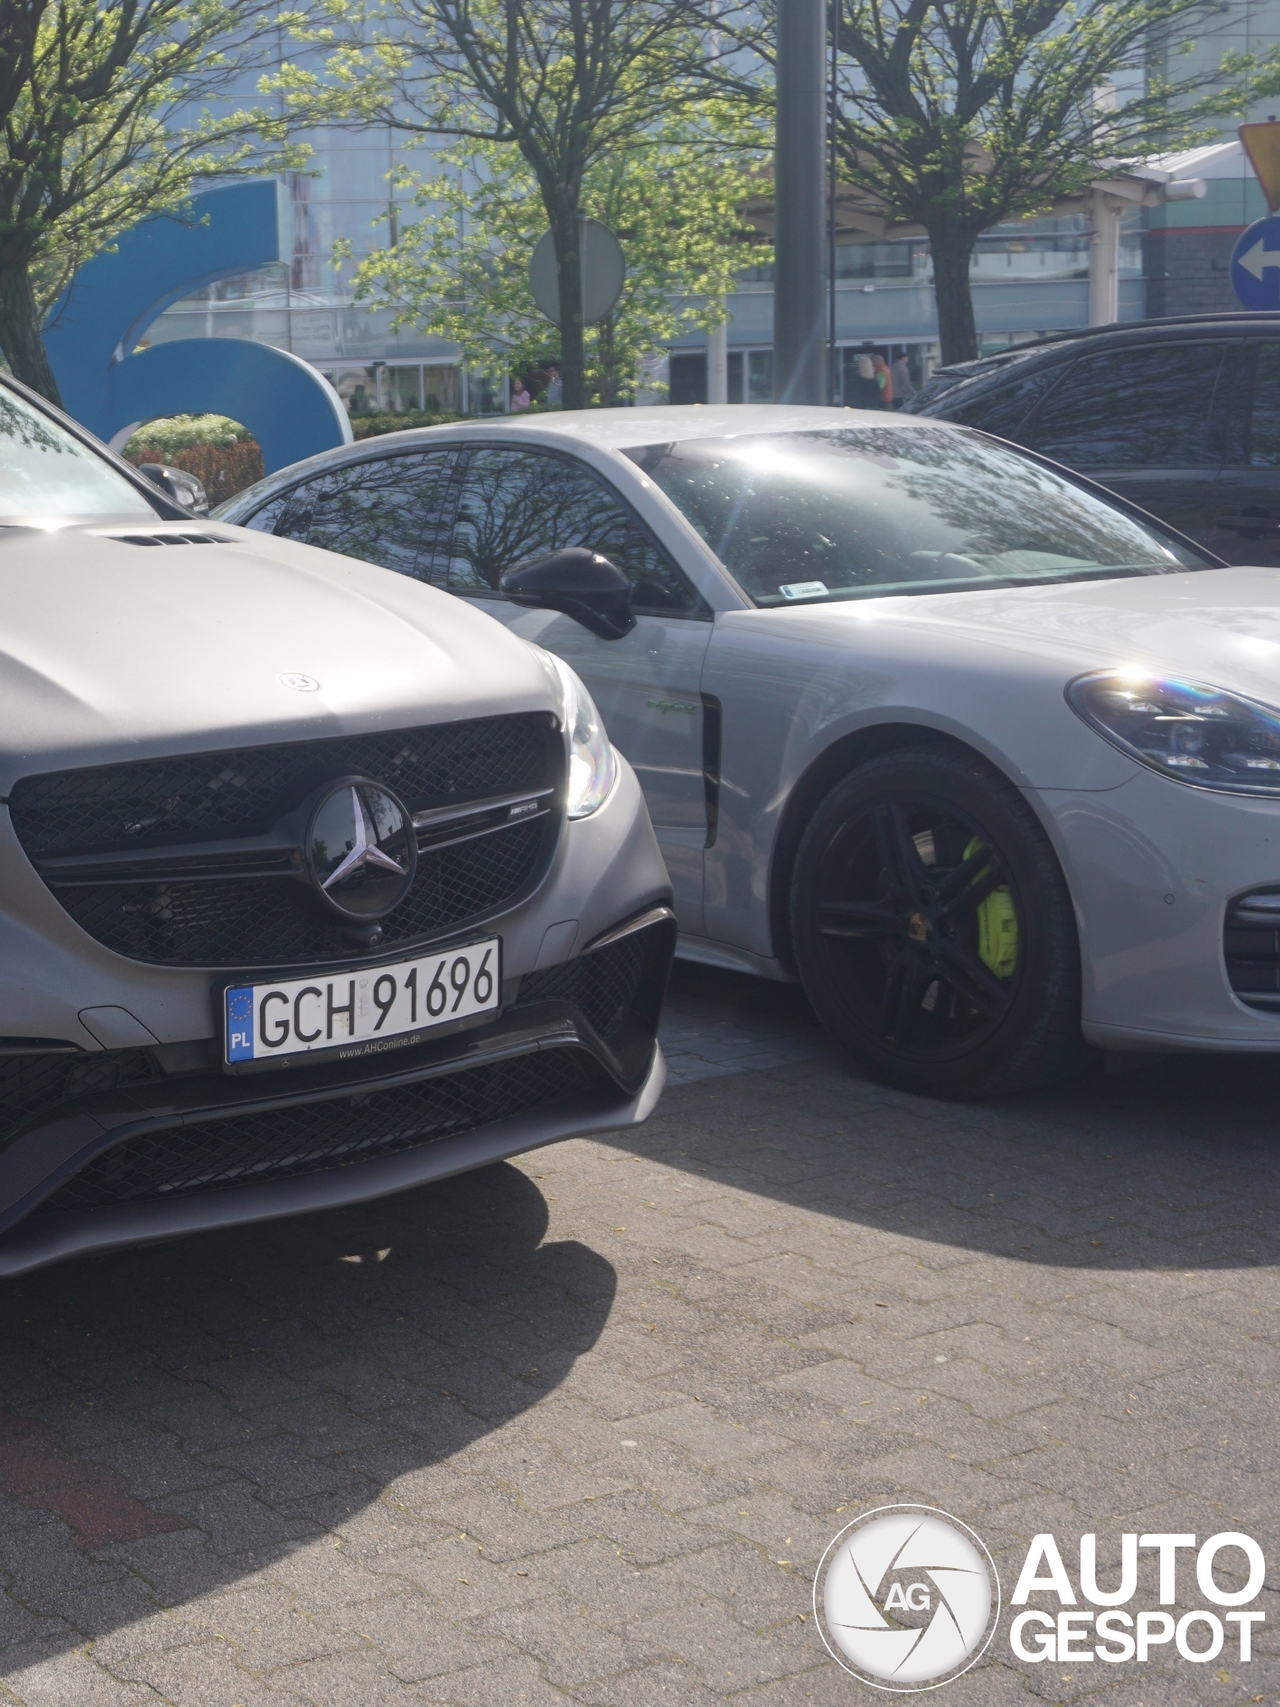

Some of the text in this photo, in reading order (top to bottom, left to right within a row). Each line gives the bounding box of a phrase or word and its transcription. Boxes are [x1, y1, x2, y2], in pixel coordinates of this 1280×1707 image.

[259, 947, 494, 1048] GCH 91696
[231, 1032, 251, 1049] PL
[339, 1033, 421, 1059] www.AHConline.de
